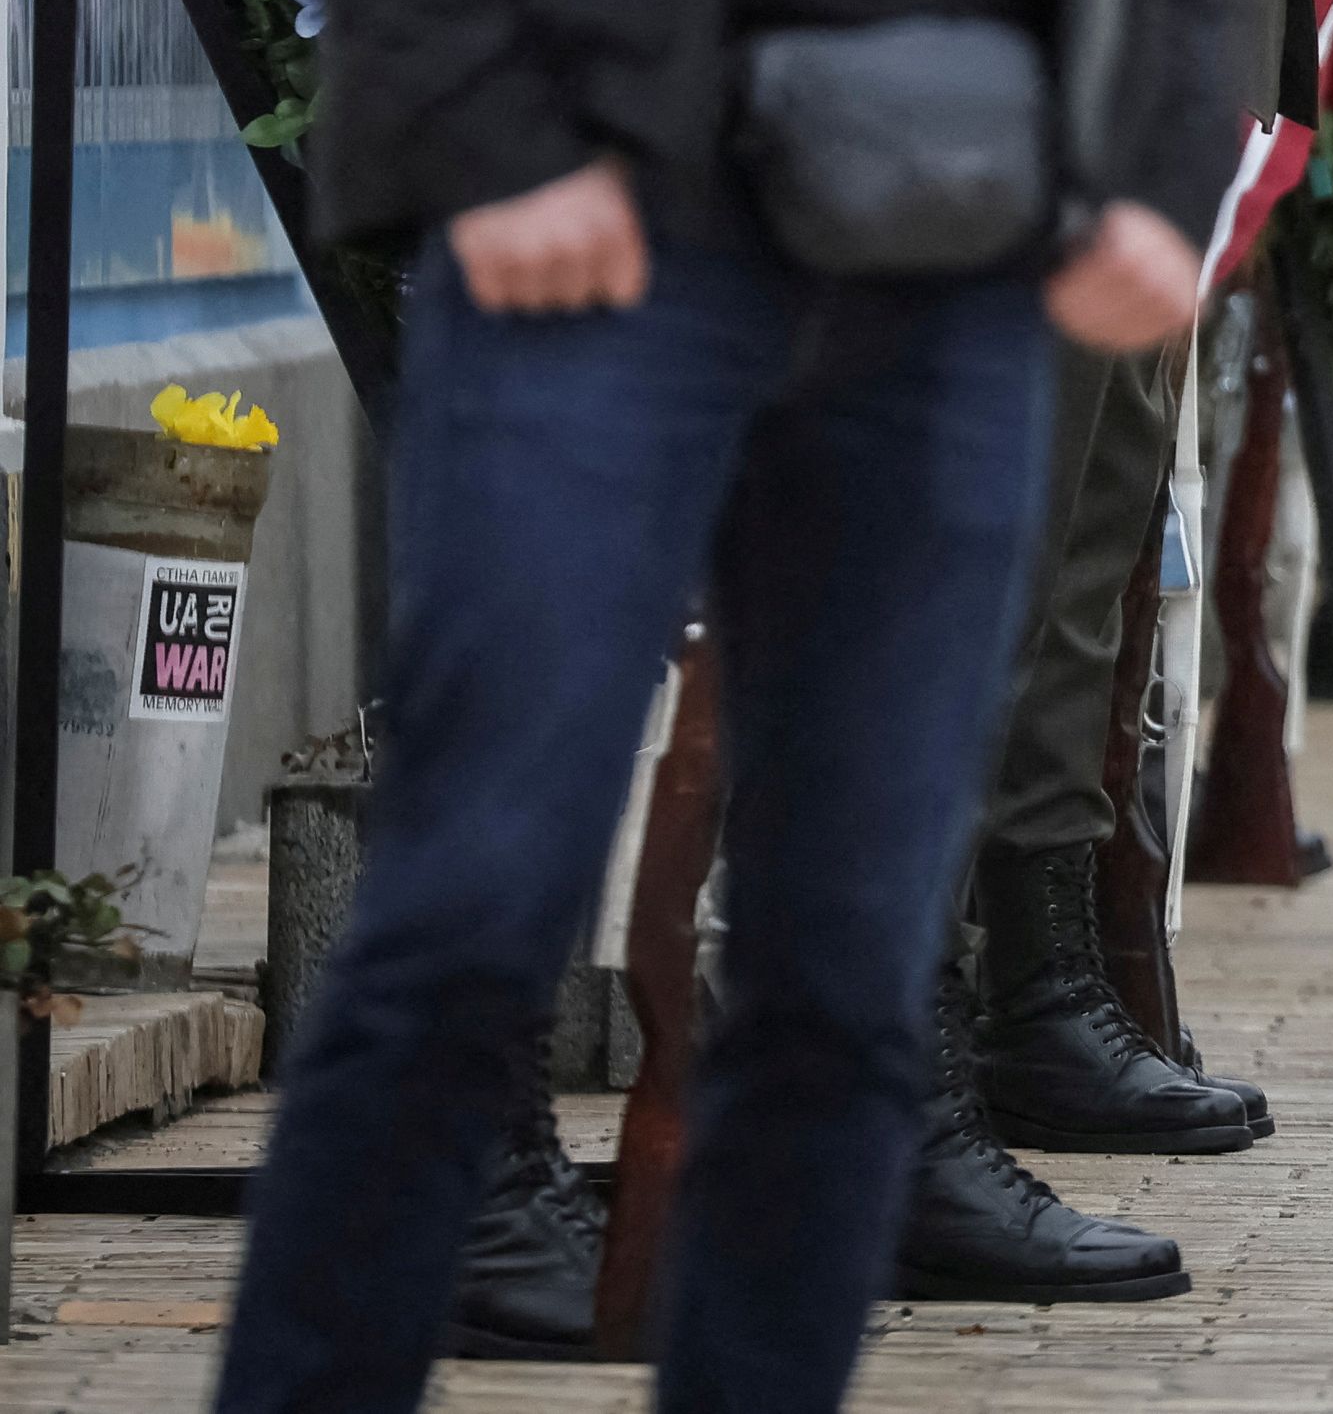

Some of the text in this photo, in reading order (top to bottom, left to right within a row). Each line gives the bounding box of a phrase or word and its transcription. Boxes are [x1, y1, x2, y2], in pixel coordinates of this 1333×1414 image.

[156, 566, 198, 584] СТІНА
[160, 590, 198, 636] UA
[204, 594, 232, 641] RU
[155, 642, 226, 693] WAR
[142, 694, 201, 713] MEMORY
